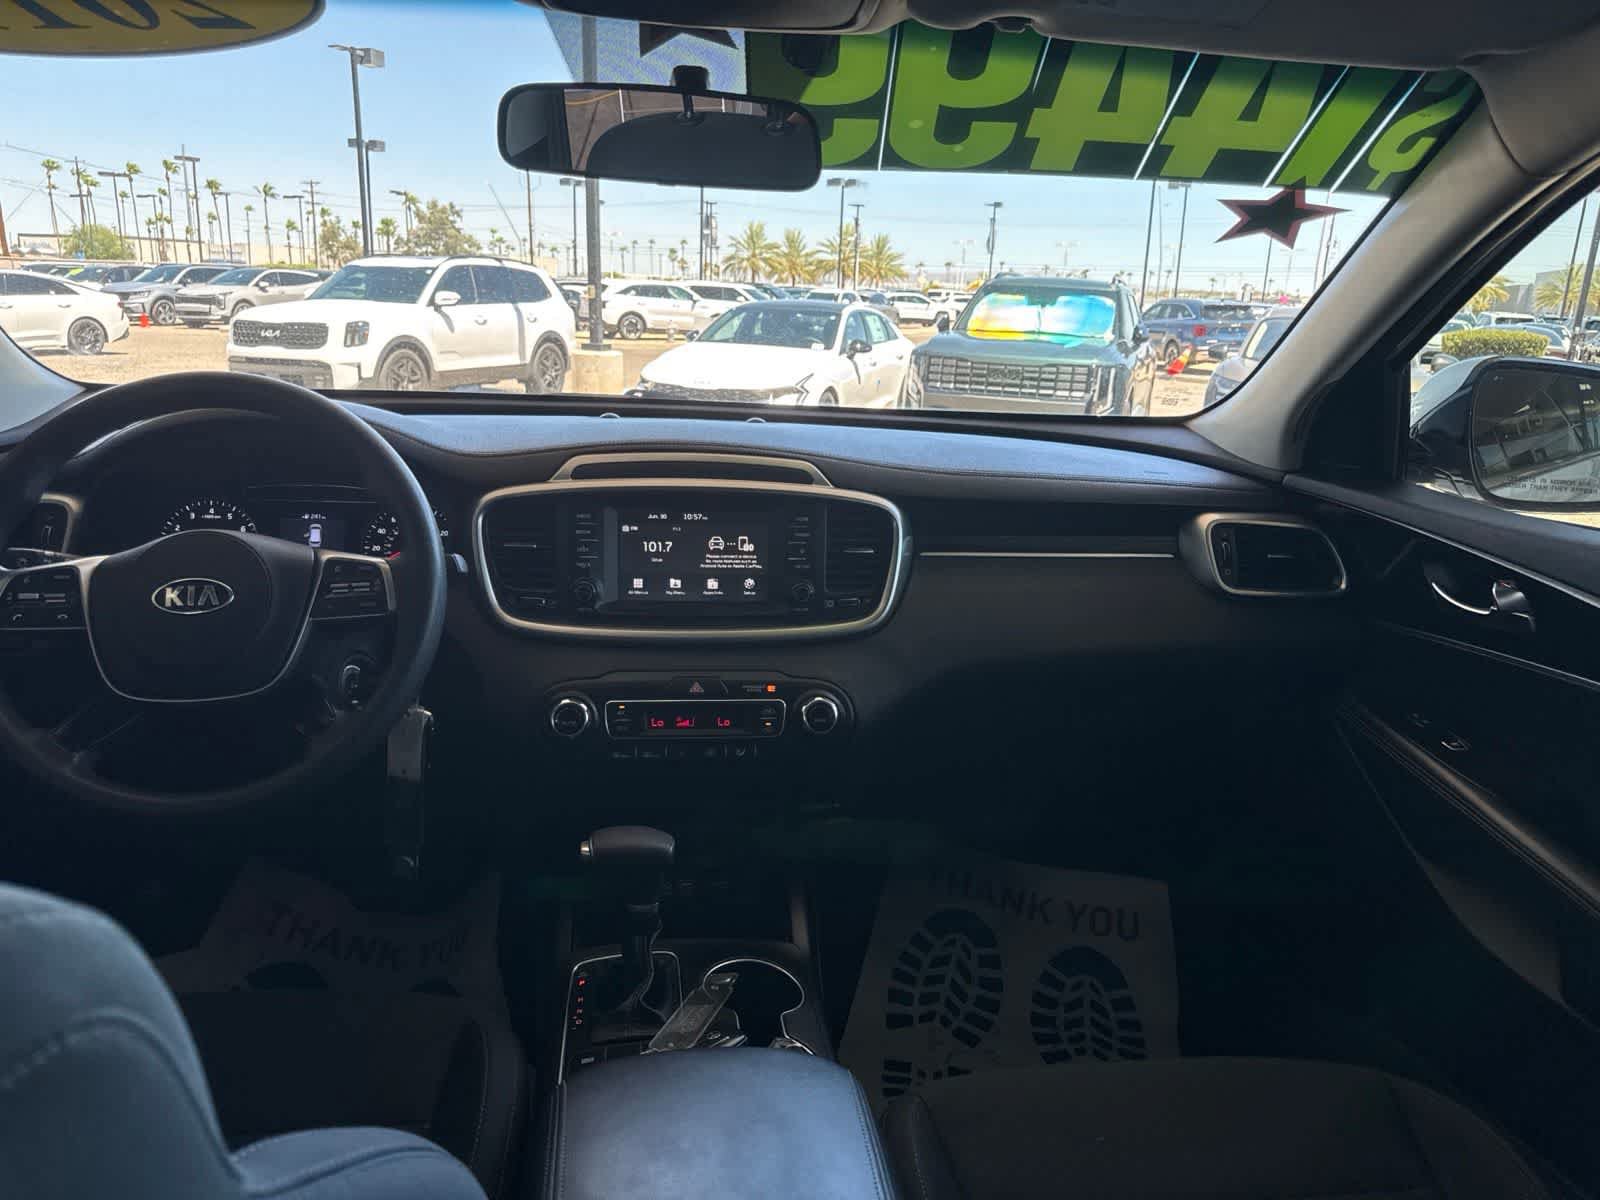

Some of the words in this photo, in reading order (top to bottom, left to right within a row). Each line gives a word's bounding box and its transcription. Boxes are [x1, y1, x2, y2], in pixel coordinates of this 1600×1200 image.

[642, 541, 673, 553] 101.7
[163, 585, 222, 608] KIA
[1064, 900, 1140, 942] YOU
